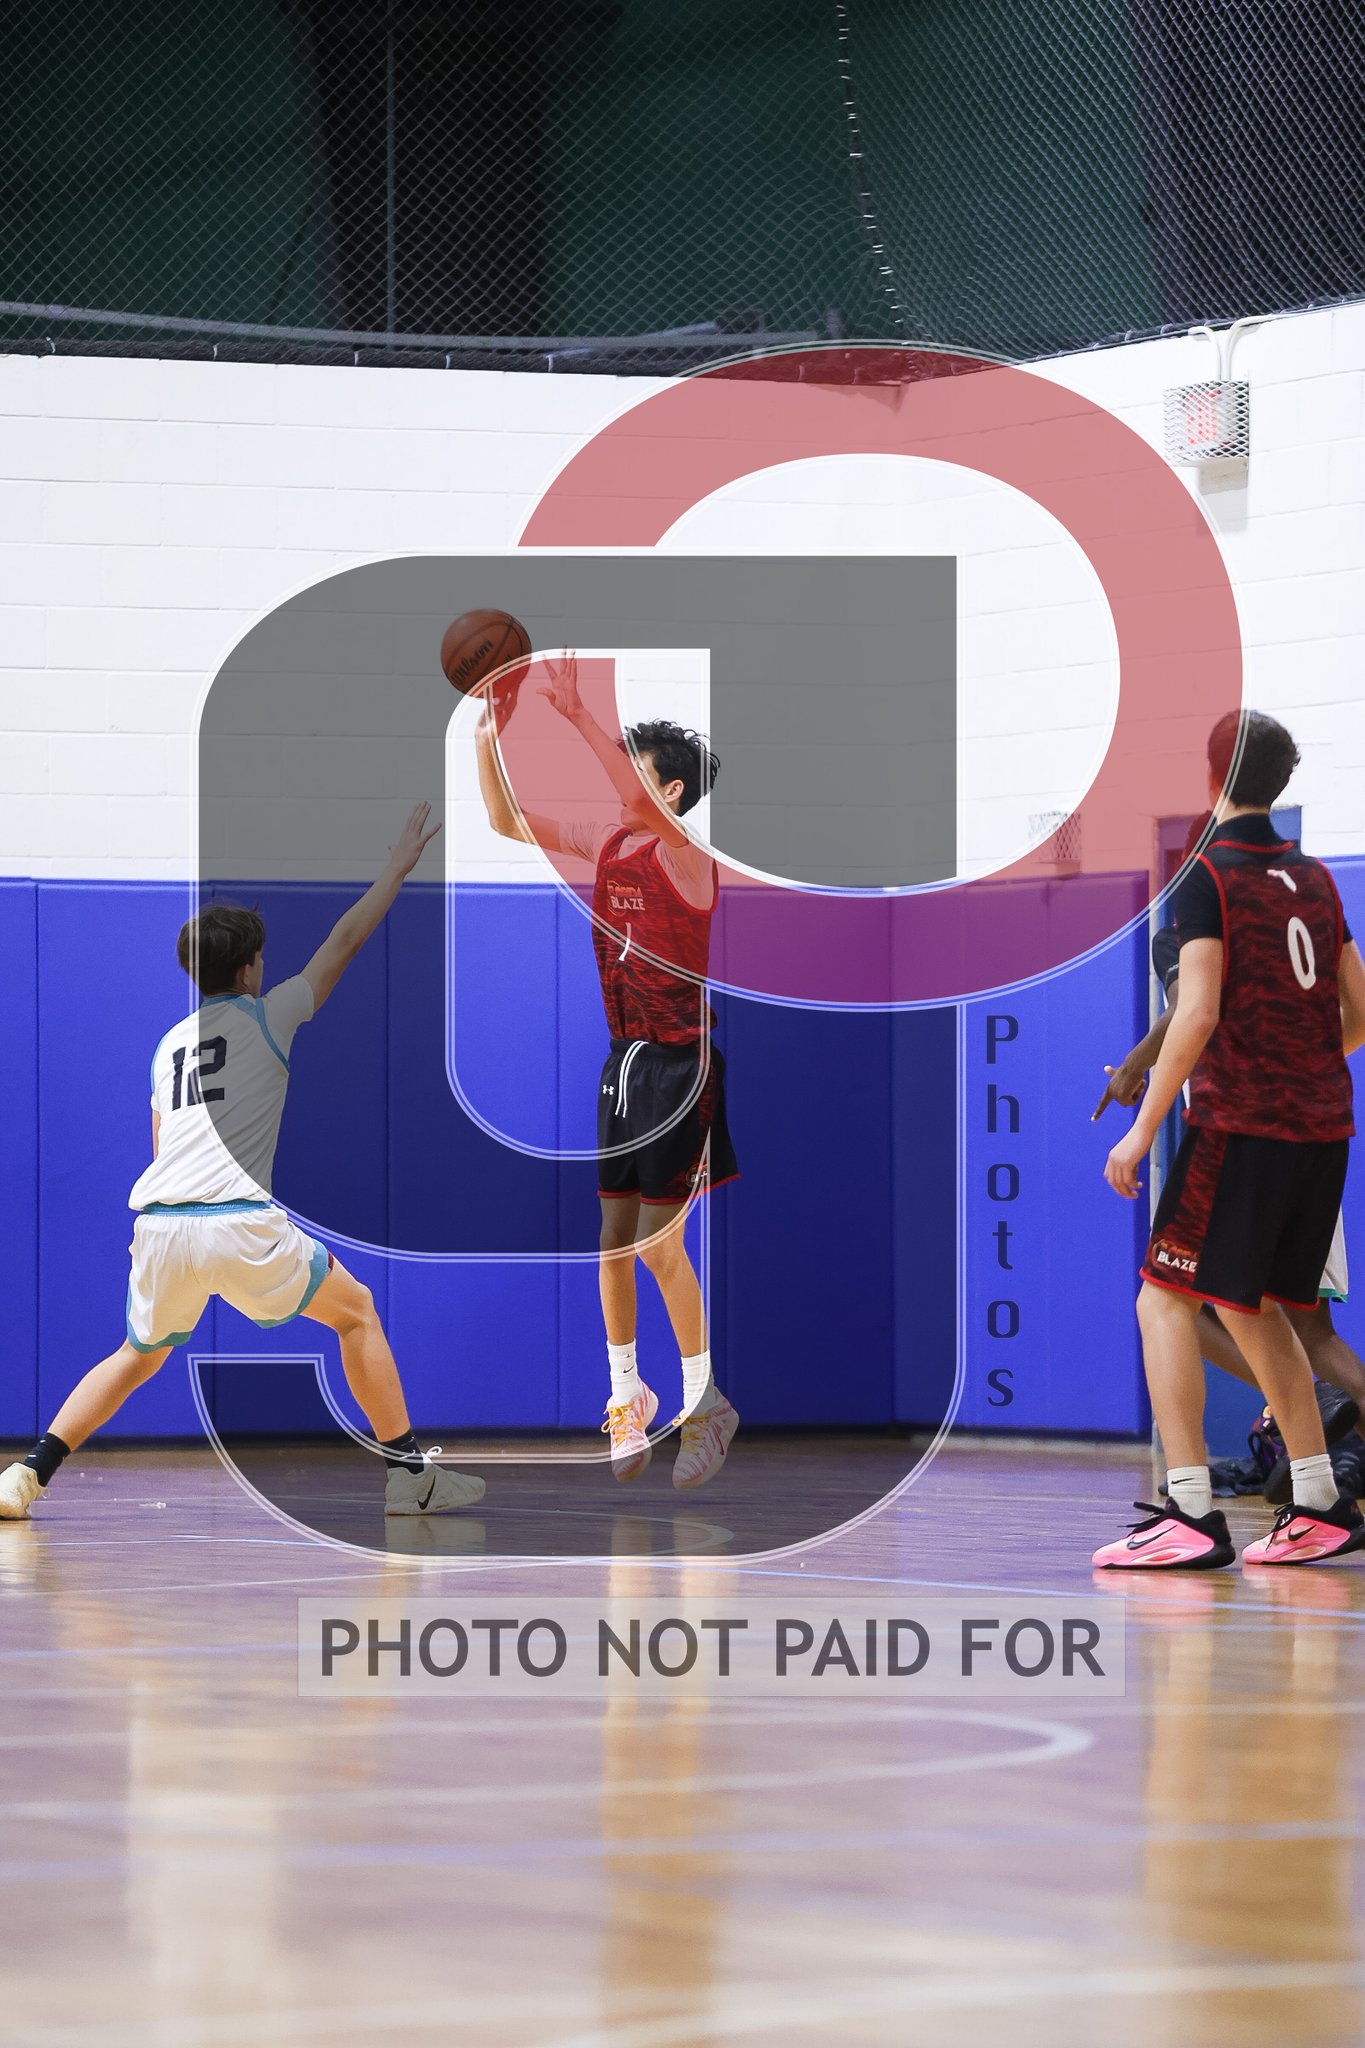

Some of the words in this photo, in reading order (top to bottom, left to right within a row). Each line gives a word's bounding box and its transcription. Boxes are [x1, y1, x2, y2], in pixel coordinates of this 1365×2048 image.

[450, 640, 494, 685] Wilson
[610, 896, 645, 911] BLAZE
[1287, 916, 1317, 989] 0
[172, 1035, 227, 1111] 12
[1157, 1250, 1198, 1273] BLAZE
